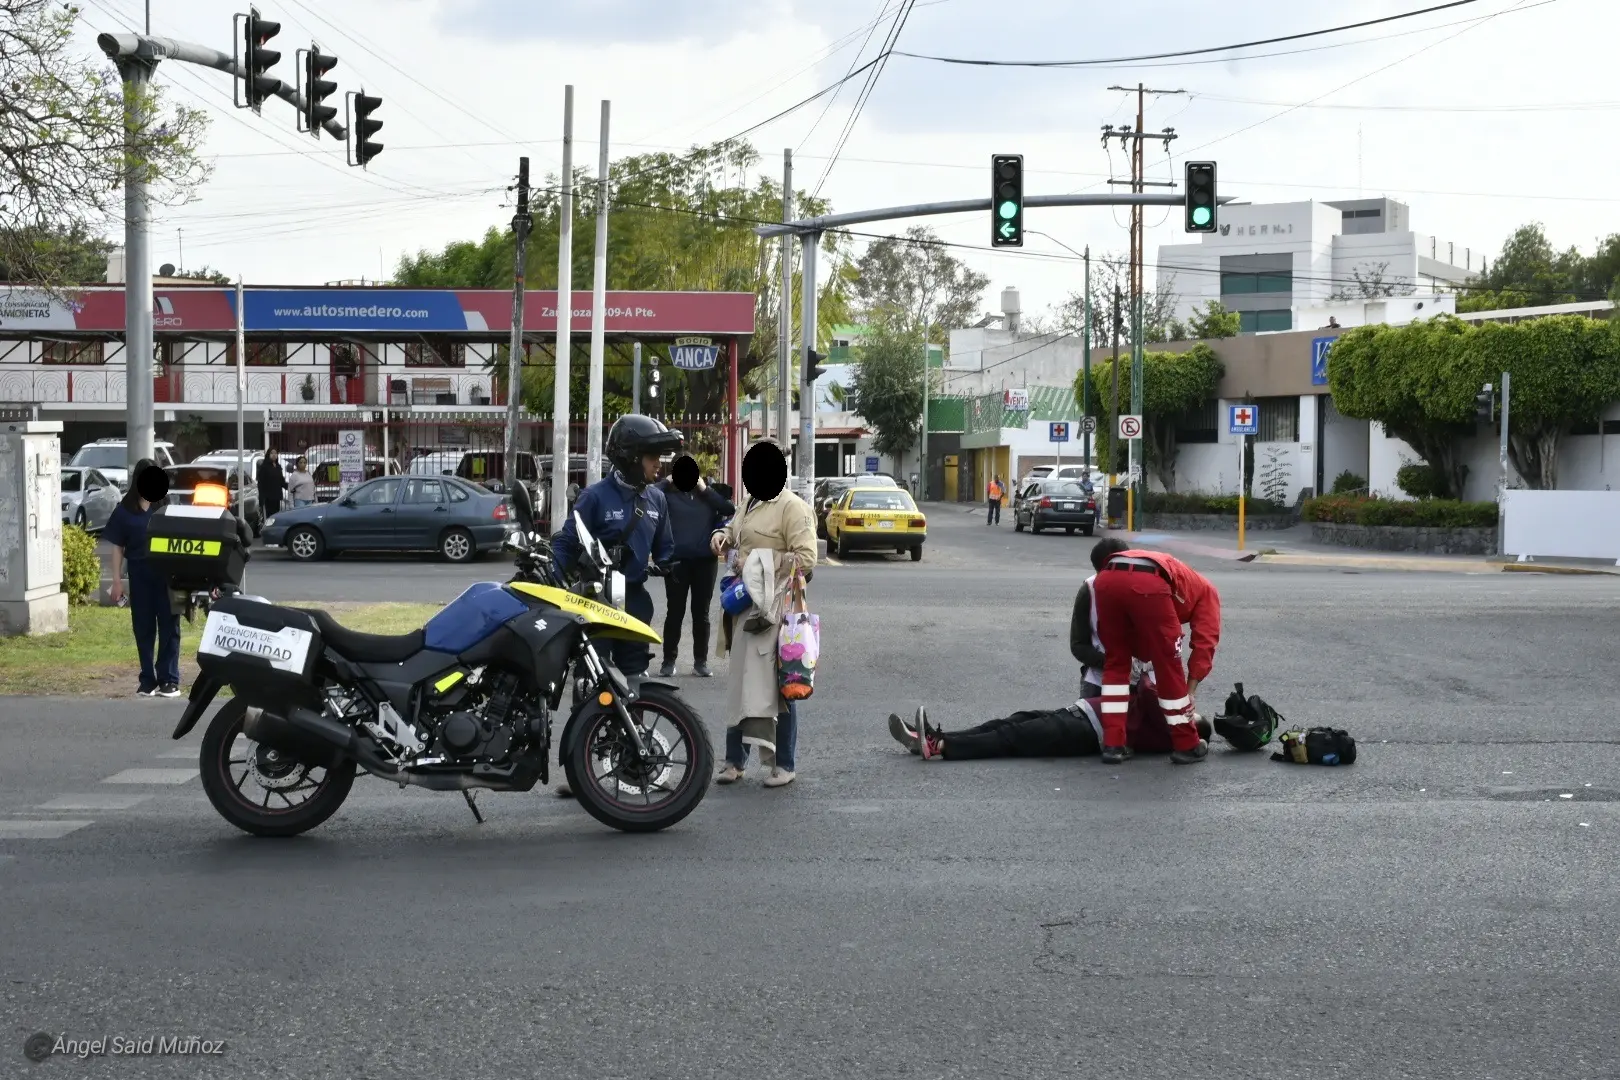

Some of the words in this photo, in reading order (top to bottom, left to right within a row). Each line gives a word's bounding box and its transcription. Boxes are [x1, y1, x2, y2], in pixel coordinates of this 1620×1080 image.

[274, 304, 429, 318] www.autosmedero.com
[635, 307, 657, 317] Pte.
[675, 347, 713, 367] ANCA
[167, 538, 205, 555] M04
[217, 624, 258, 640] AGENCIA
[260, 633, 273, 644] DE
[214, 634, 292, 661] MOVILIDAD
